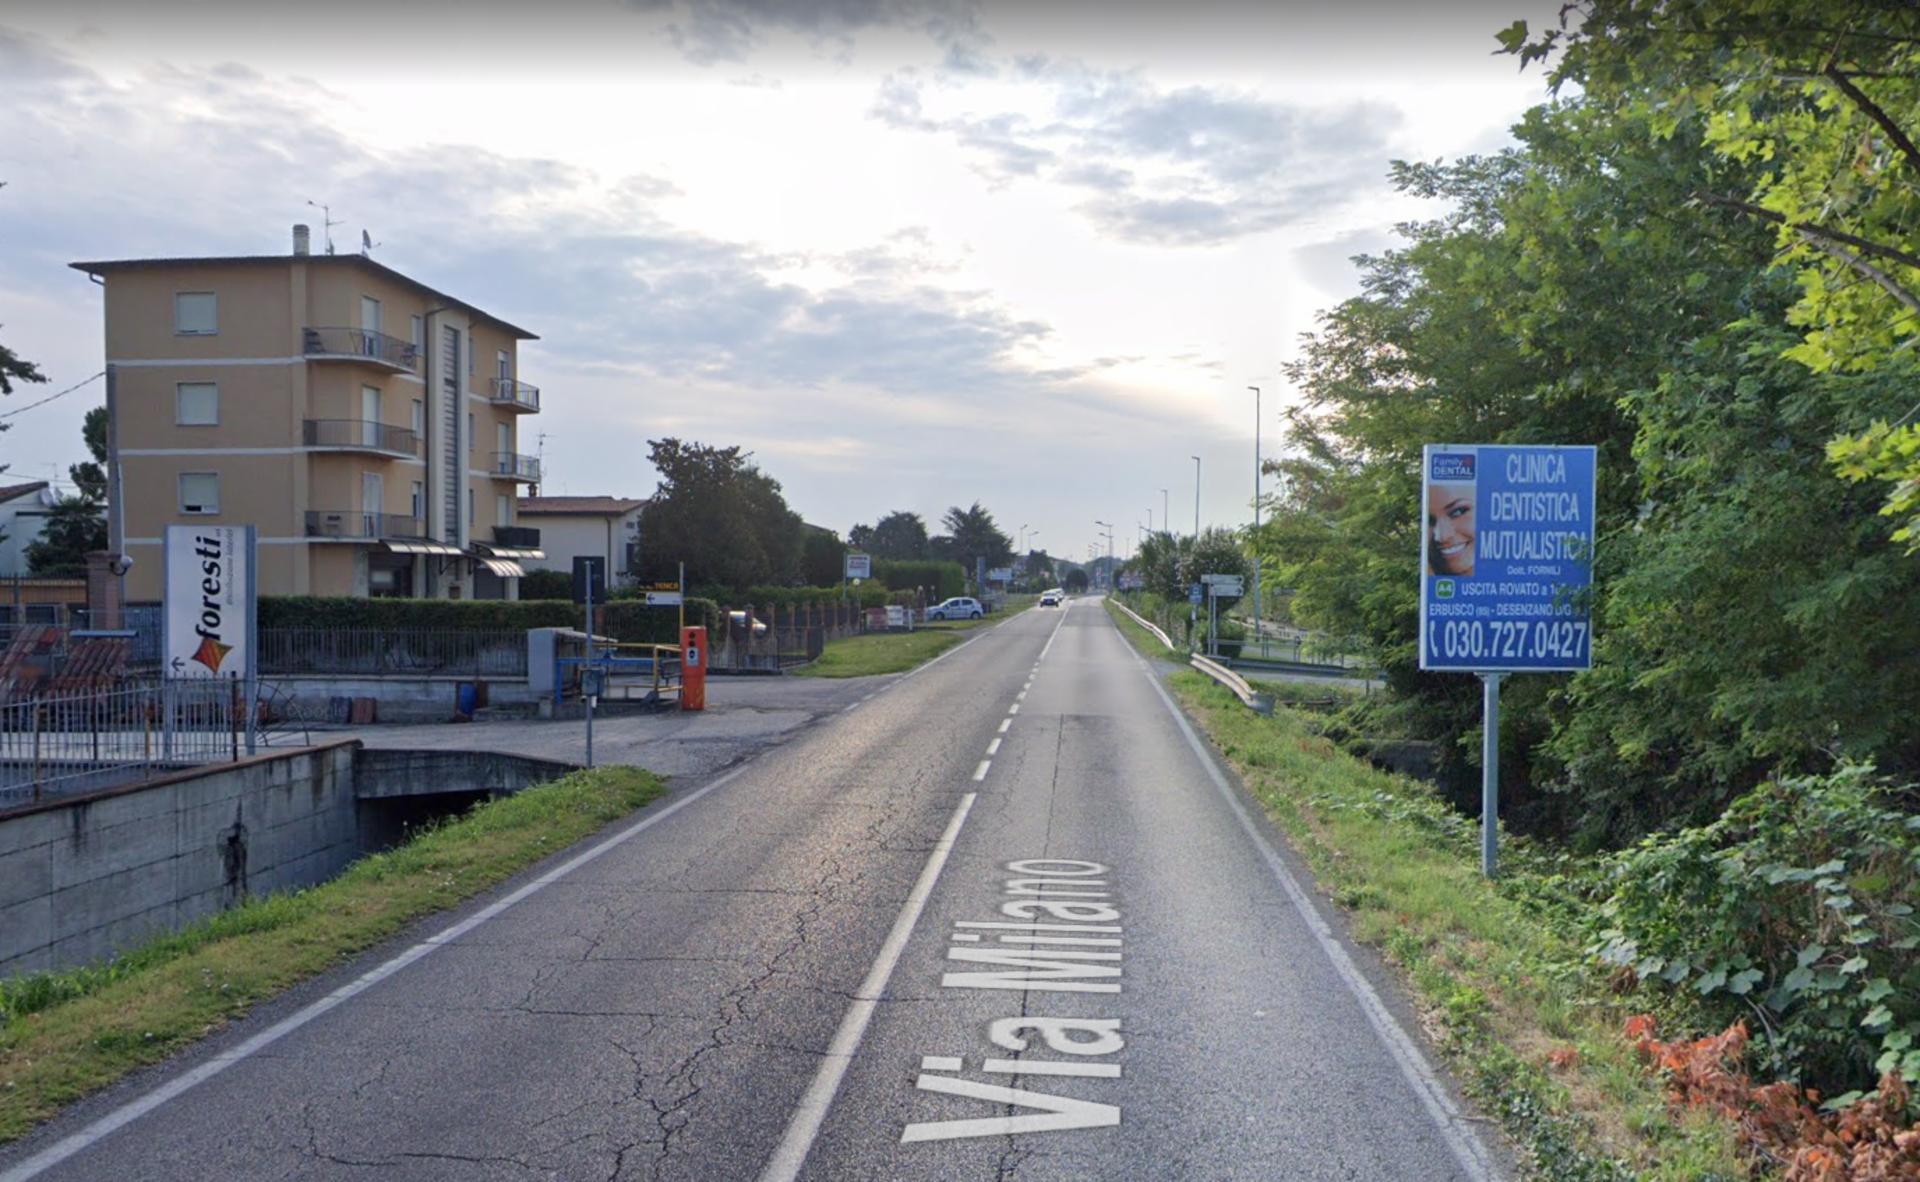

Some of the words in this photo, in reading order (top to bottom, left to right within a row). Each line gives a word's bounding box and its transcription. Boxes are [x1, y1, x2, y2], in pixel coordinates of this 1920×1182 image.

[1433, 466, 1473, 476] DENTAL
[1506, 453, 1566, 484] CLINICA
[1491, 492, 1580, 522] DENTISTICA
[195, 536, 221, 640] foresti
[1438, 584, 1452, 593] A4
[1461, 582, 1497, 596] USCITA
[1499, 582, 1540, 596] ROVATO
[1429, 603, 1474, 616] ERBUSCO
[1496, 603, 1553, 616] DESENZANO
[1444, 621, 1587, 658] 030.727.0427
